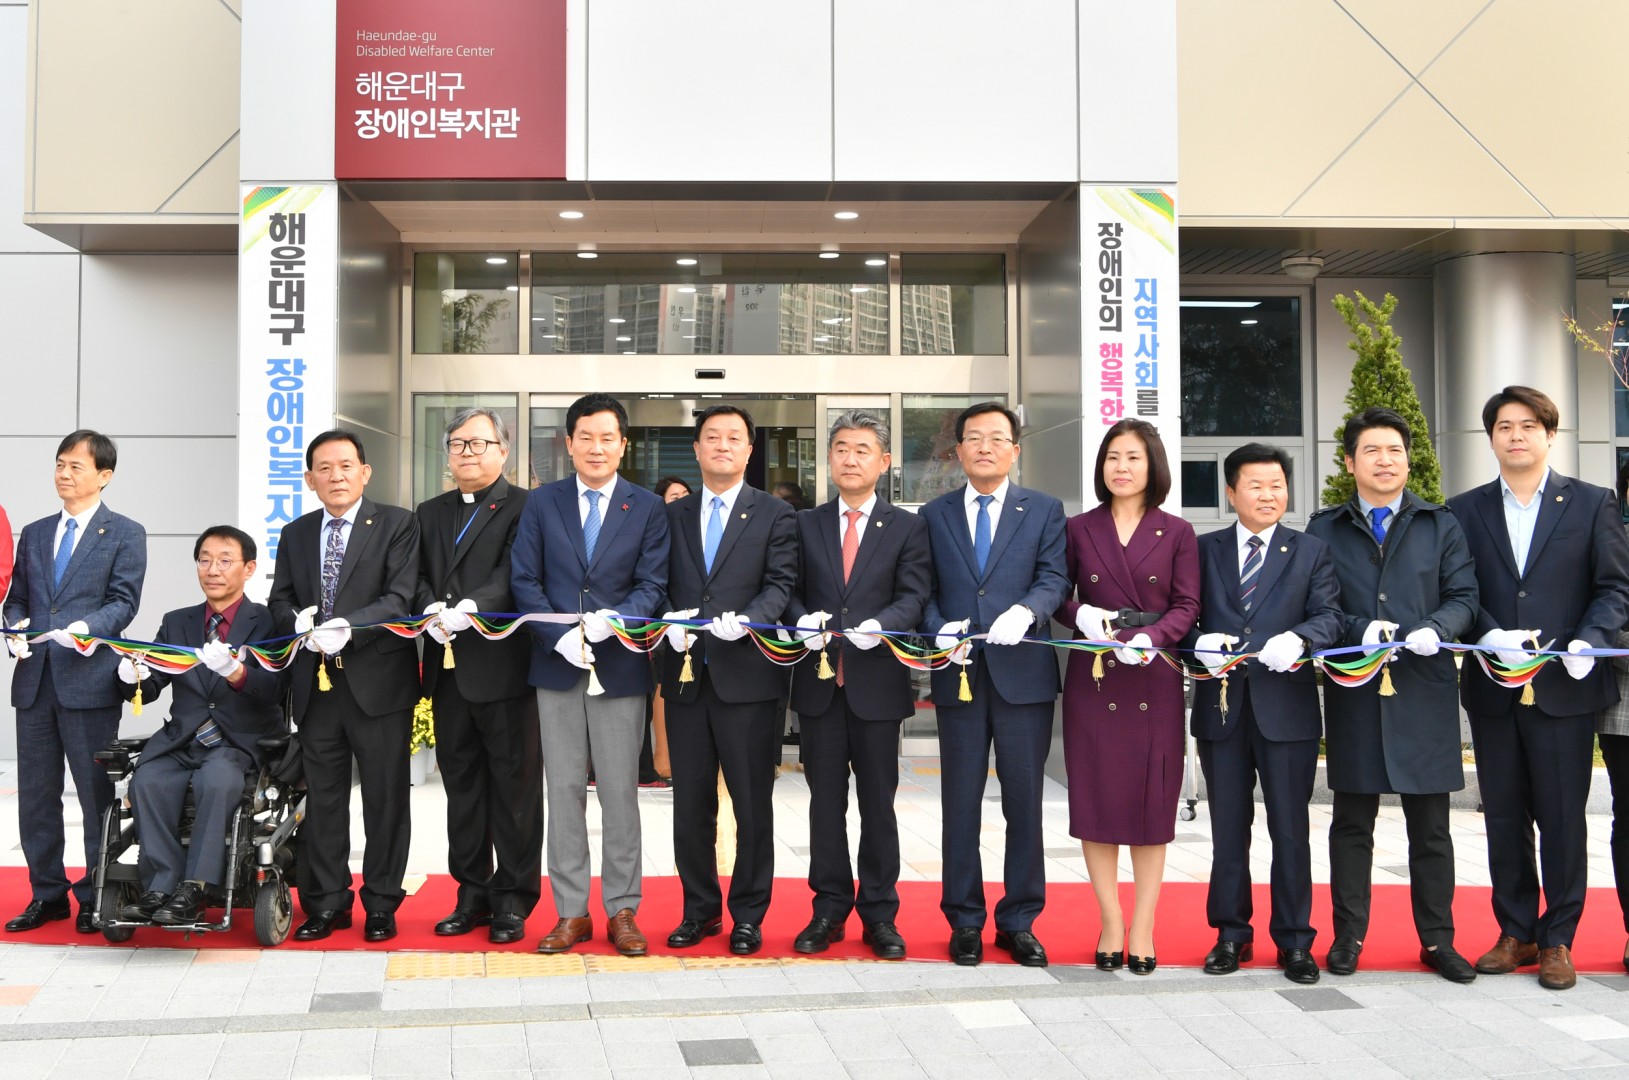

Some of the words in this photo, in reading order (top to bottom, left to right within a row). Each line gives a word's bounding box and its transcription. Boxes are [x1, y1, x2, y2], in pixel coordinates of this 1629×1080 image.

[356, 29, 437, 43] Haeundae-gu
[356, 45, 406, 57] Disabled
[409, 45, 454, 57] Welfare
[456, 45, 495, 57] Center
[355, 71, 466, 102] 해운대구
[354, 107, 521, 139] 장애인복지관
[268, 212, 306, 346] 해운대구
[1097, 222, 1124, 333] 장애인의
[1133, 278, 1160, 417] 지역사회를
[1099, 342, 1125, 426] 행복한
